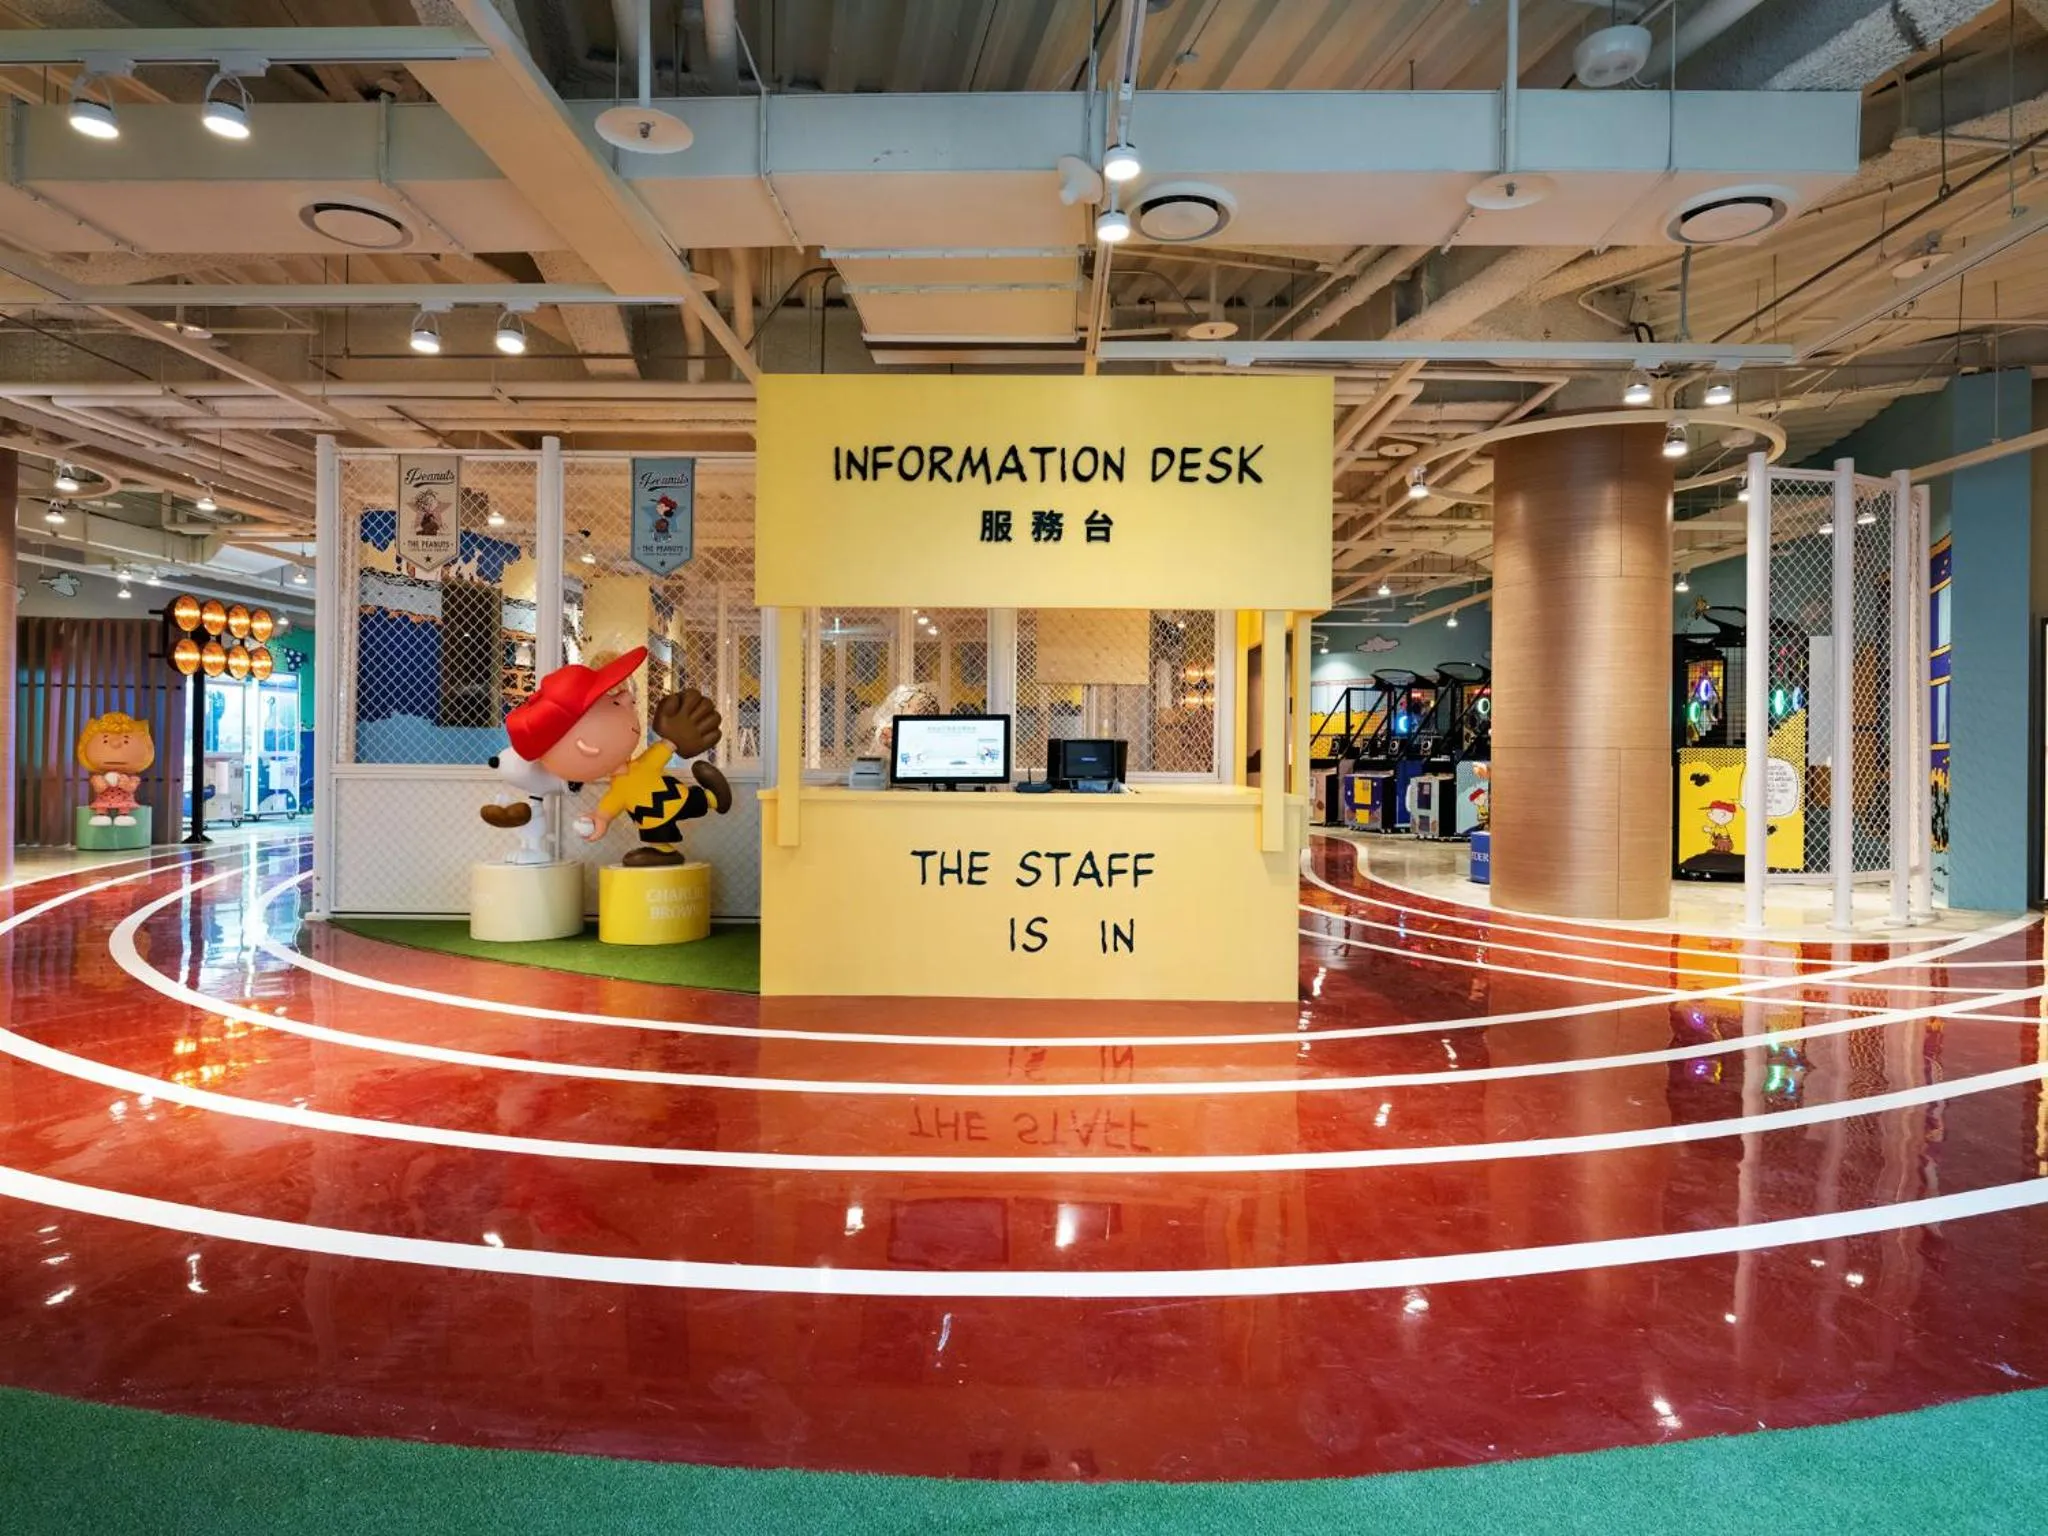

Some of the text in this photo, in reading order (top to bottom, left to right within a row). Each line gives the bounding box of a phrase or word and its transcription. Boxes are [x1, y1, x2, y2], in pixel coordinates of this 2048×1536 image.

[403, 467, 455, 486] Peanuts
[834, 444, 1264, 486] INFORMATION DESK
[639, 471, 689, 489] Peanuts
[979, 509, 1114, 543] 服務台
[407, 539, 450, 549] THE PEANUTS
[656, 545, 684, 554] PEANUTS
[910, 849, 1156, 888] THE STAFF
[1009, 916, 1135, 954] IS IN
